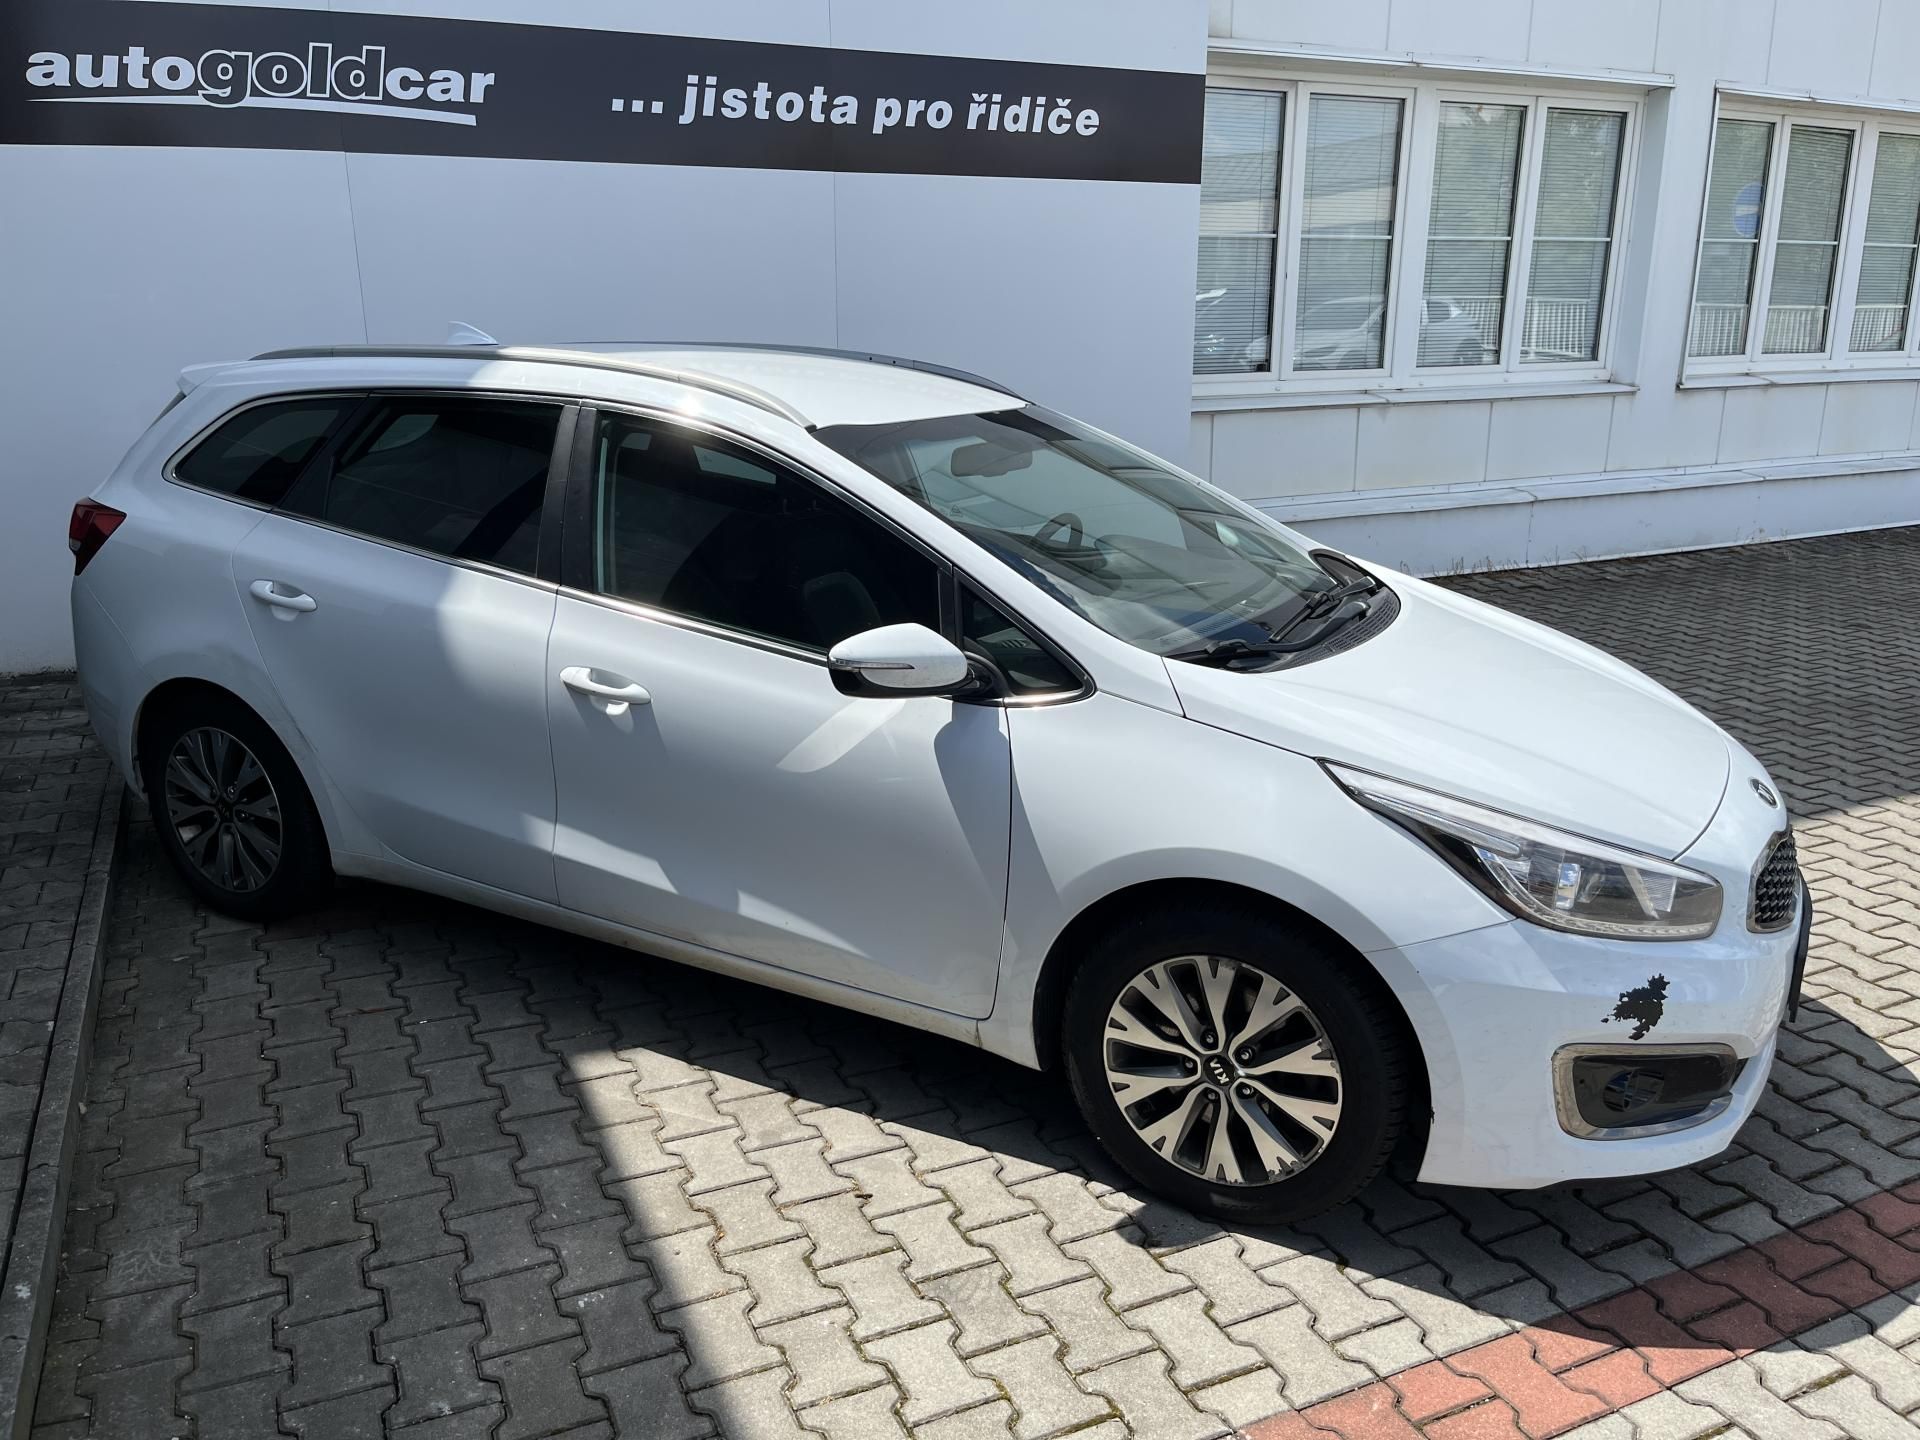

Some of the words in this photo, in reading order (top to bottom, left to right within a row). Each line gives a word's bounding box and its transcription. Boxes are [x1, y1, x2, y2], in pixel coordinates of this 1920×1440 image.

[25, 42, 496, 108] autogoldcar
[678, 74, 859, 125] jistota
[872, 97, 953, 135] pro
[966, 92, 1100, 137] řidiče
[1209, 1058, 1230, 1084] KIA
